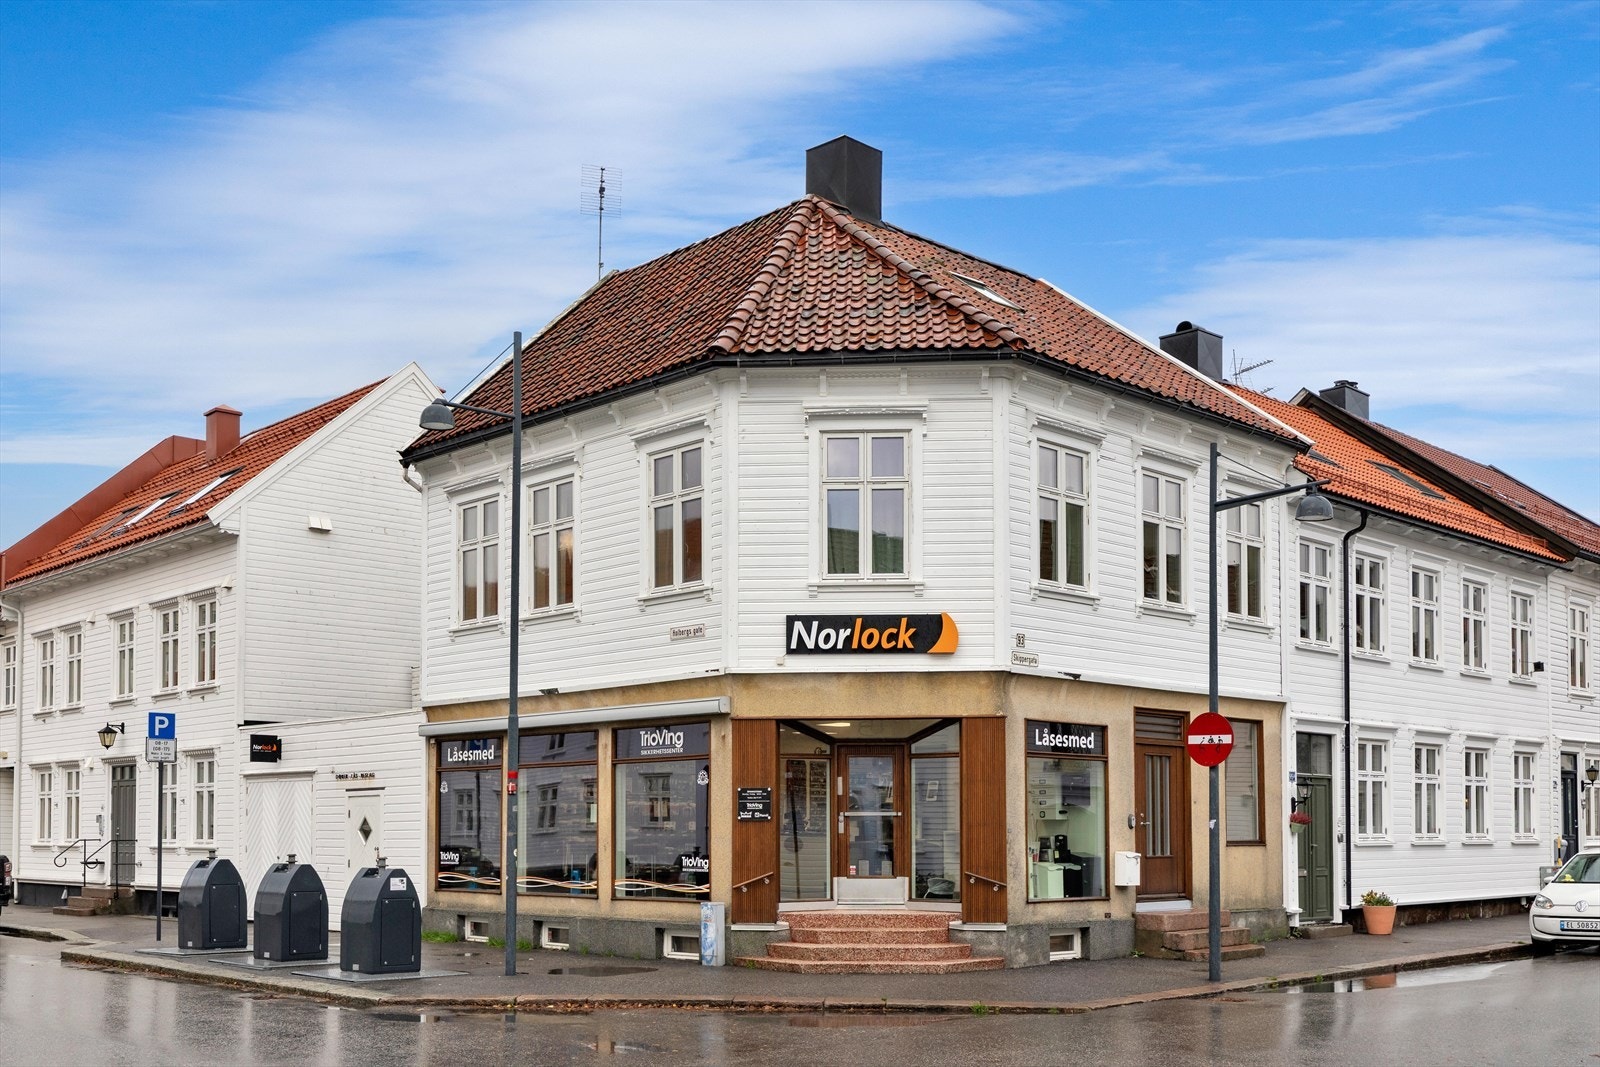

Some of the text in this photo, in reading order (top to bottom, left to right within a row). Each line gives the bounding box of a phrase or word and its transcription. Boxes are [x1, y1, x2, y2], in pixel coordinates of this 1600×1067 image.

[790, 617, 917, 650] Norlock
[154, 715, 169, 736] P
[640, 729, 684, 748] TrioVing
[1035, 728, 1095, 749] Låsesmed
[447, 745, 495, 762] Låsesmed
[681, 856, 709, 870] TrioVing
